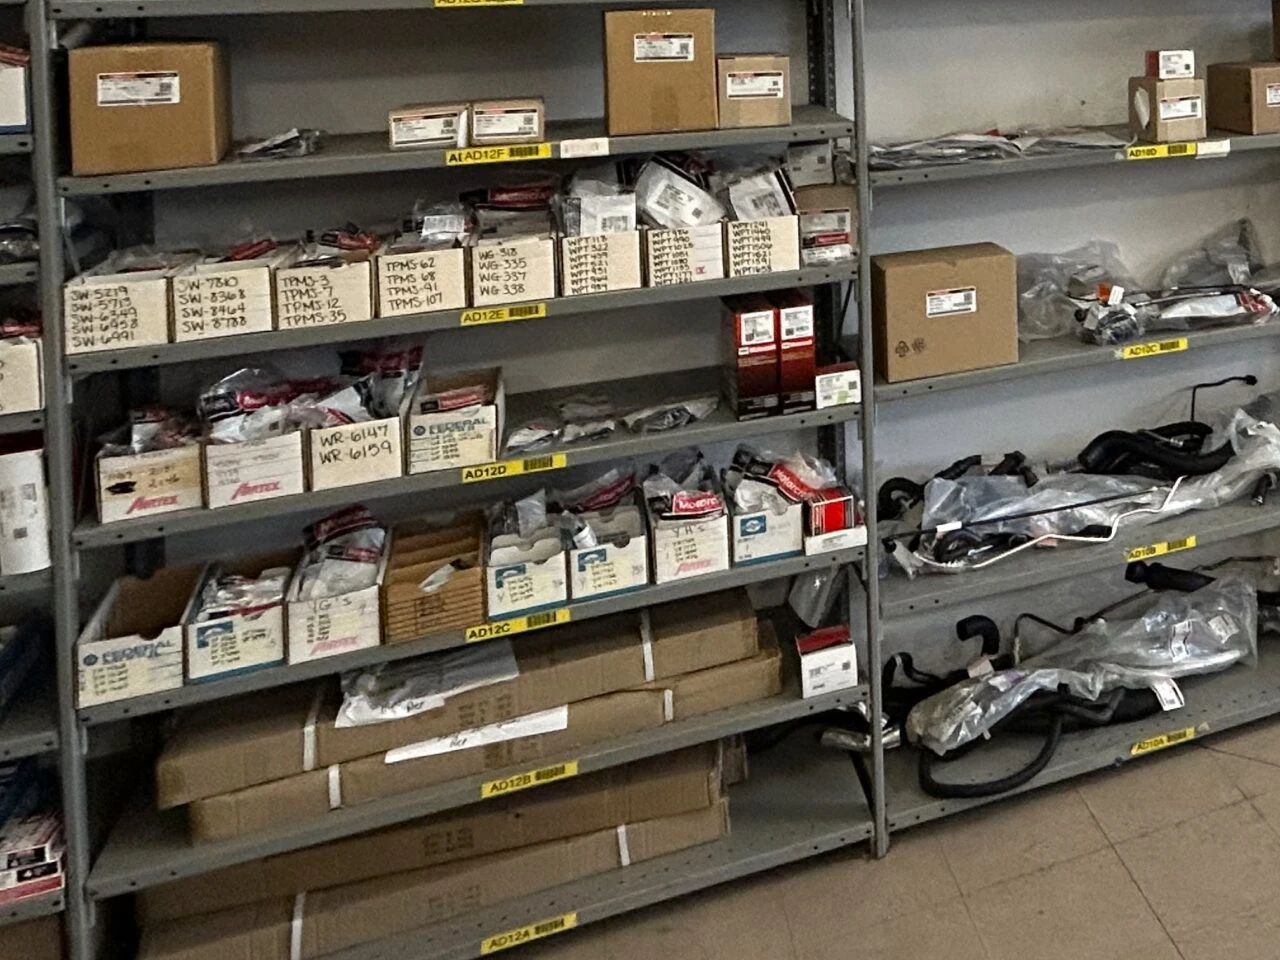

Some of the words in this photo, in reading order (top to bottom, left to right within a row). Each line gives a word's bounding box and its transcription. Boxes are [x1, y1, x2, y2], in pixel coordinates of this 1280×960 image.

[464, 149, 505, 160] AD12F
[478, 247, 518, 260] WG-318
[385, 257, 436, 272] TPMS-62
[478, 258, 527, 270] WG-335
[281, 274, 330, 288] TPMS-3
[478, 271, 527, 282] WG-337
[281, 286, 334, 301] TPMS-7
[387, 282, 438, 296] TPMS-91
[479, 283, 526, 296] WG-338
[178, 290, 246, 305] SW-8368
[388, 292, 443, 311] TPMS-107
[181, 303, 246, 318] SW-8464
[282, 298, 342, 314] TPMS-12
[283, 310, 347, 327] TPMS-35
[463, 309, 505, 323] AD12E
[464, 465, 507, 480] AD12D
[468, 623, 511, 639] AD12C
[489, 774, 533, 793] AD12B
